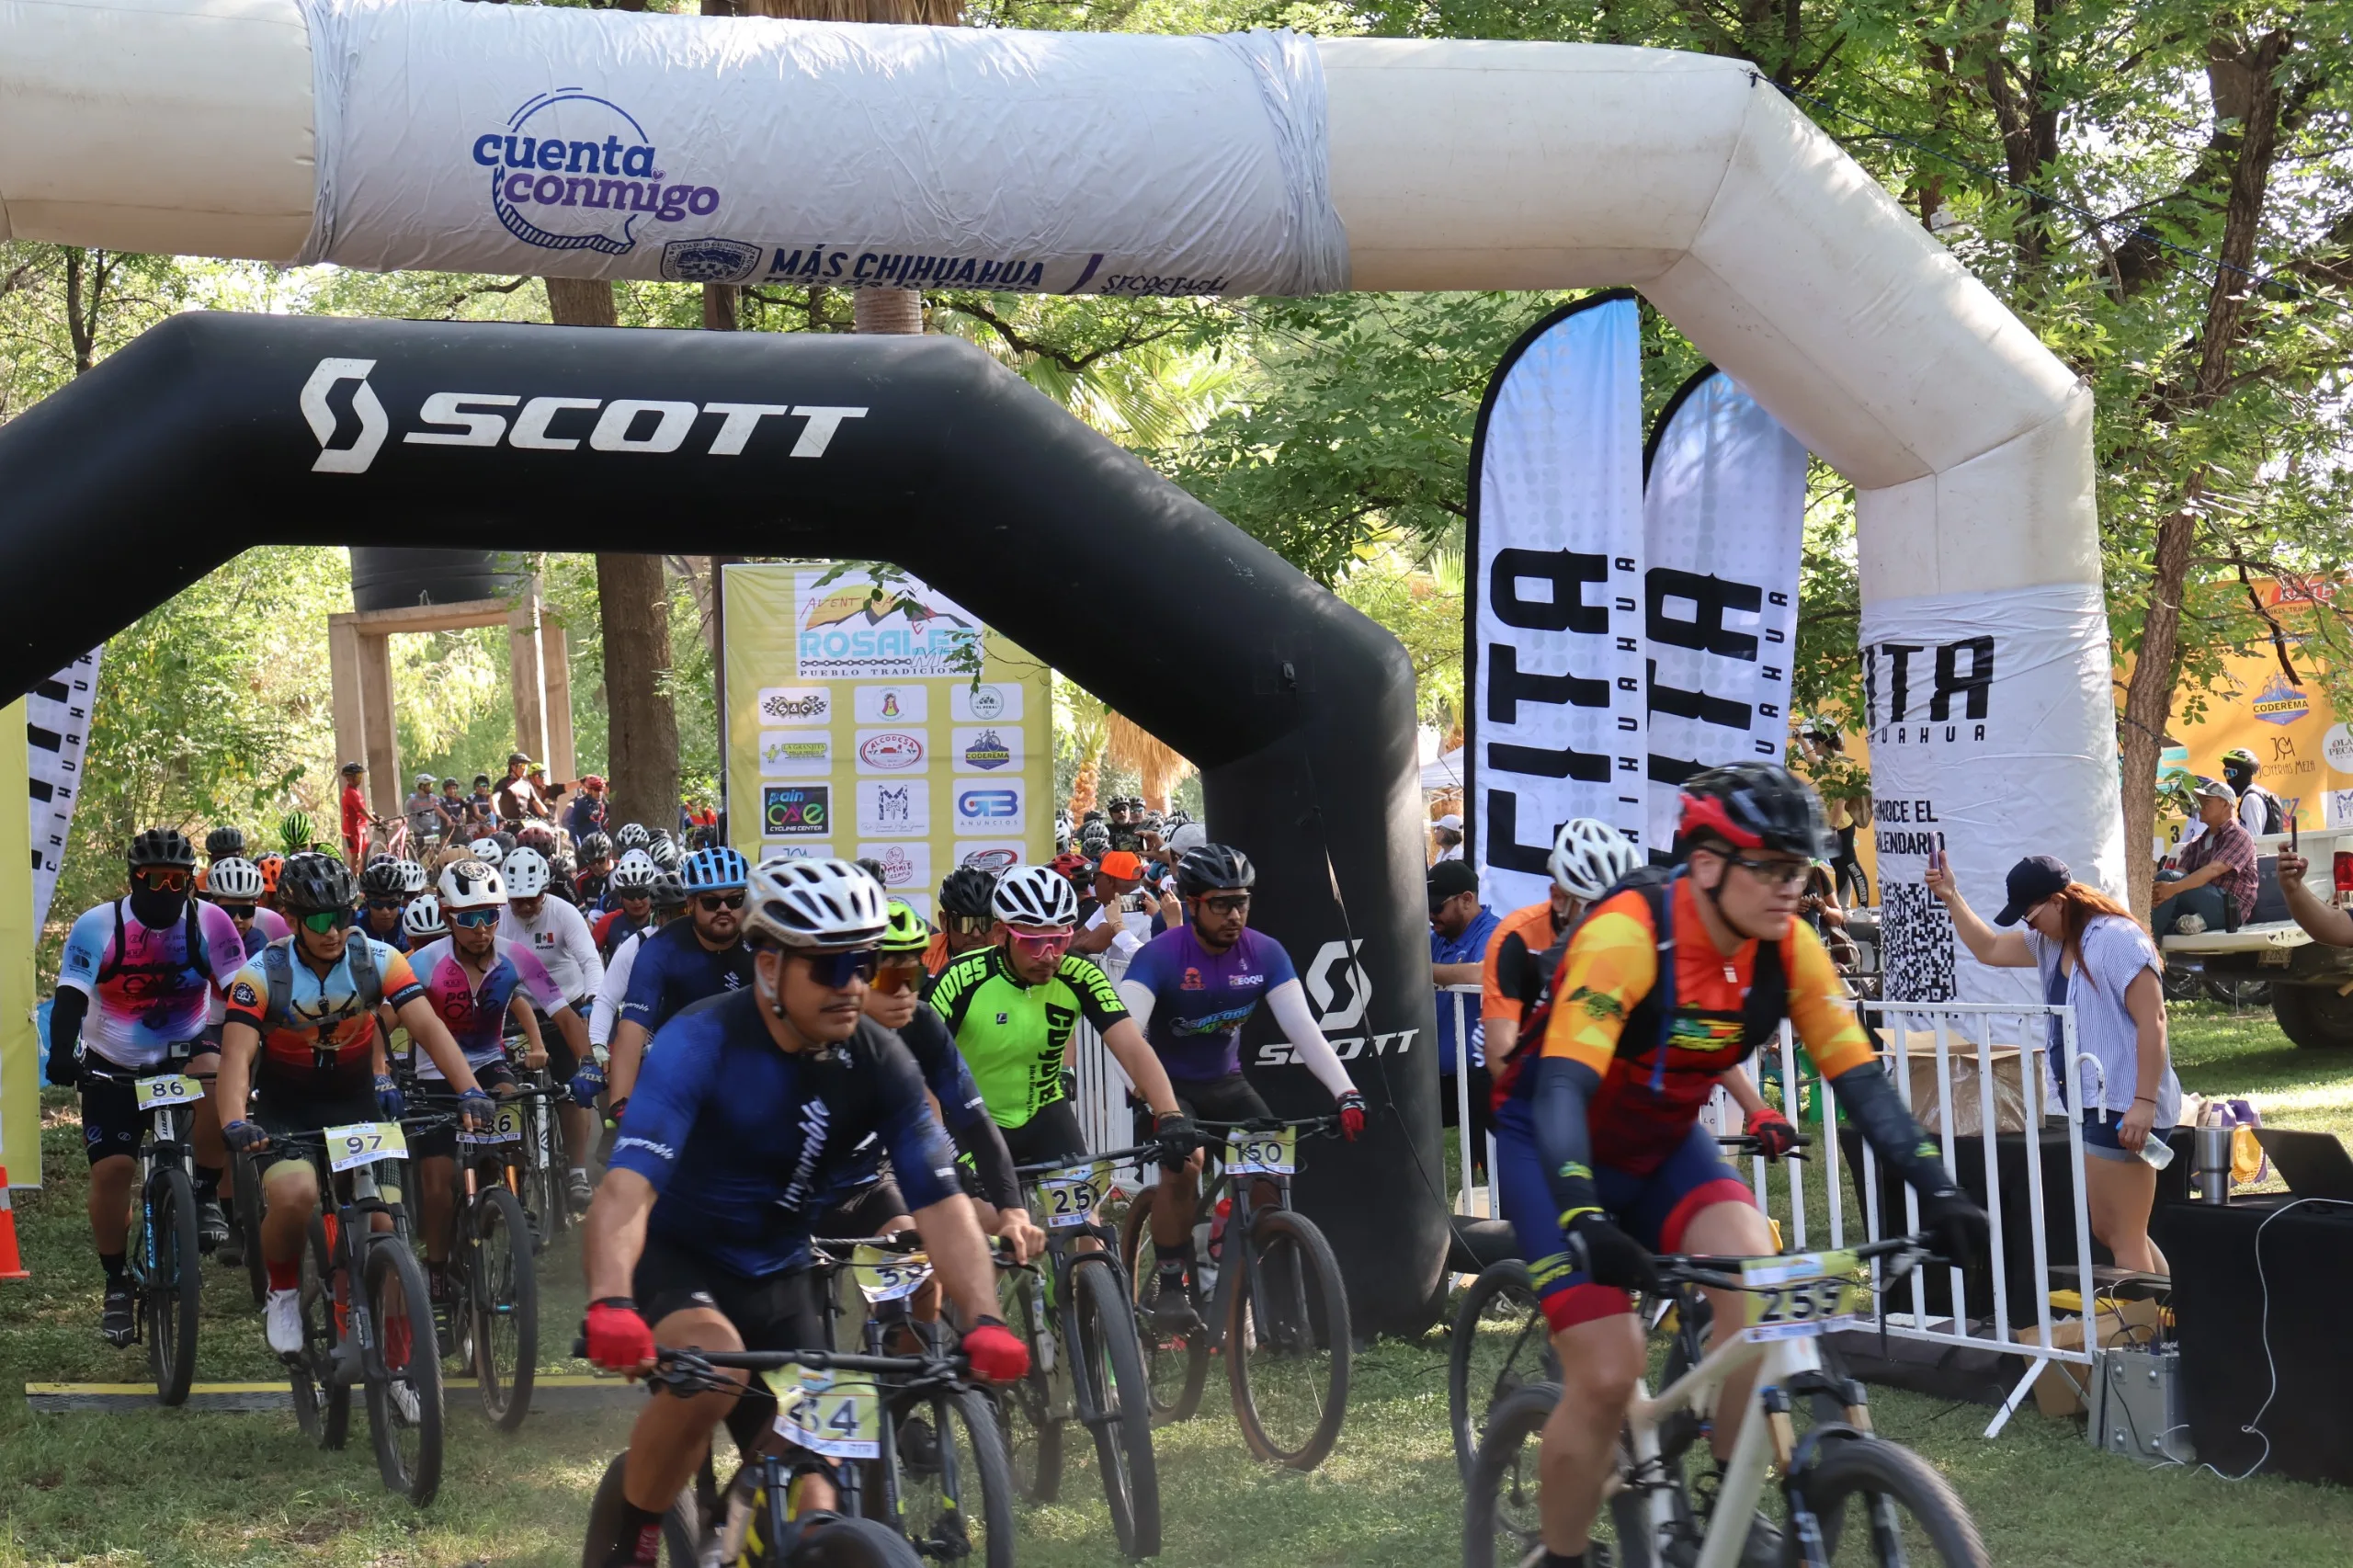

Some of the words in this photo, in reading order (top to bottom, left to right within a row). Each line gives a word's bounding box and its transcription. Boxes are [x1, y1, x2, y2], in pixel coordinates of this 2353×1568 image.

[472, 133, 655, 178] cuenta
[504, 173, 720, 222] conmigo
[767, 244, 848, 277] MÁS
[853, 253, 1044, 287] CHIHUAHUA
[403, 392, 870, 458] SCOTT
[800, 596, 896, 619] AVENTRA
[910, 645, 980, 669] MT
[800, 669, 859, 677] PUEBLO
[1755, 591, 1788, 756] UAHUA
[1615, 557, 1639, 844] HIHUAHUA
[2253, 700, 2309, 713] CODEREMA
[1645, 567, 1762, 869] ITA
[870, 736, 914, 751] ALCODESA
[1870, 724, 1985, 744] UAHUA
[966, 751, 1009, 759] CODEREMA
[1915, 801, 1938, 822] EL
[1875, 831, 1945, 855] ALENDARIO
[1255, 1028, 1420, 1066] SOTT
[153, 1082, 185, 1098] 86
[346, 1135, 382, 1154] 97
[1234, 1142, 1282, 1164] 150
